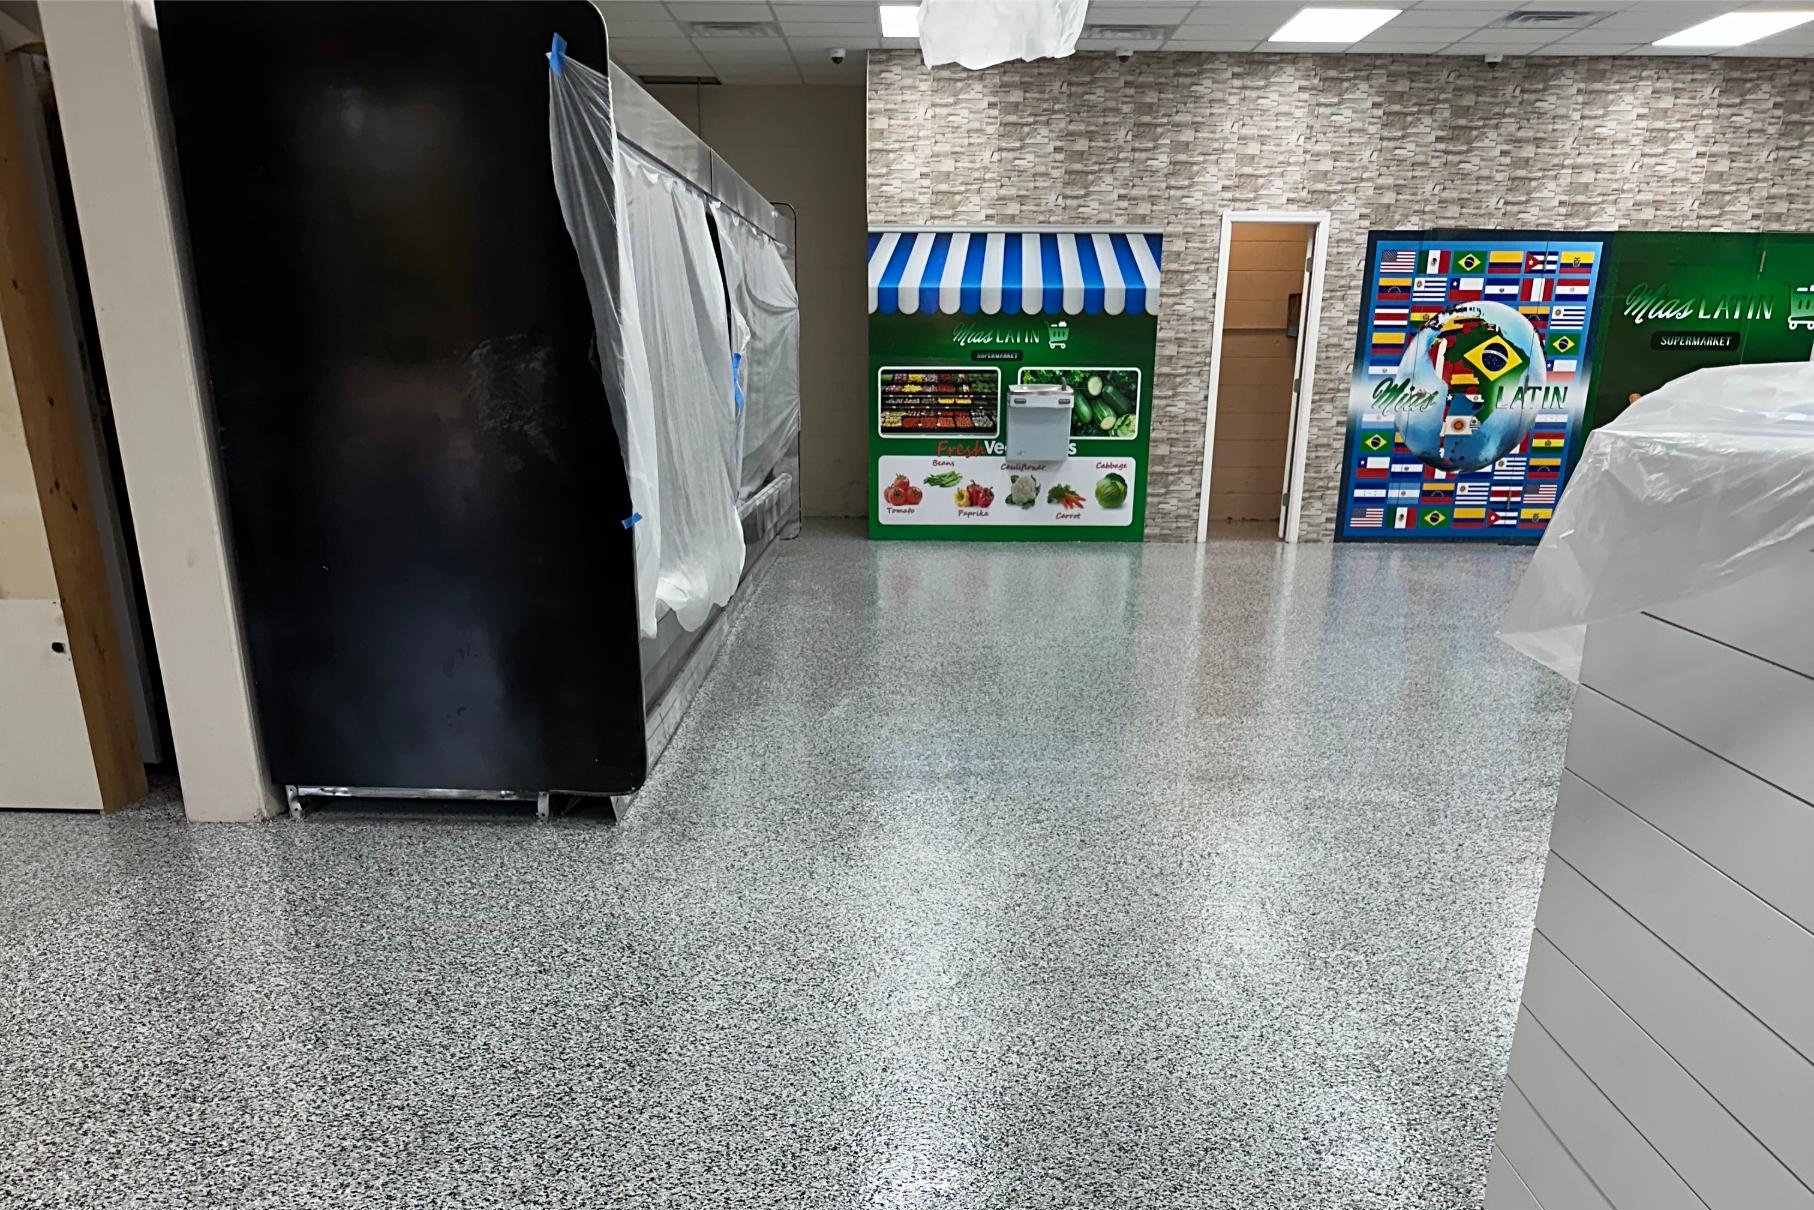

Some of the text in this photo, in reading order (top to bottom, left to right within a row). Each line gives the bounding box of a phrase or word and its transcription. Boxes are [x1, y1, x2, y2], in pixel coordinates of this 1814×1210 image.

[1624, 283, 1774, 324] Mias LATIN
[995, 328, 1040, 344] LATIN
[1660, 336, 1732, 347] SUPERMARKET
[1495, 386, 1568, 410] LATIN
[936, 440, 985, 458] Fresh
[1001, 463, 1047, 471] Cauliflower
[1096, 461, 1128, 470] Cabbage
[886, 506, 916, 515] Tomato
[958, 509, 990, 518] Paprika
[1056, 512, 1081, 520] Carrot
